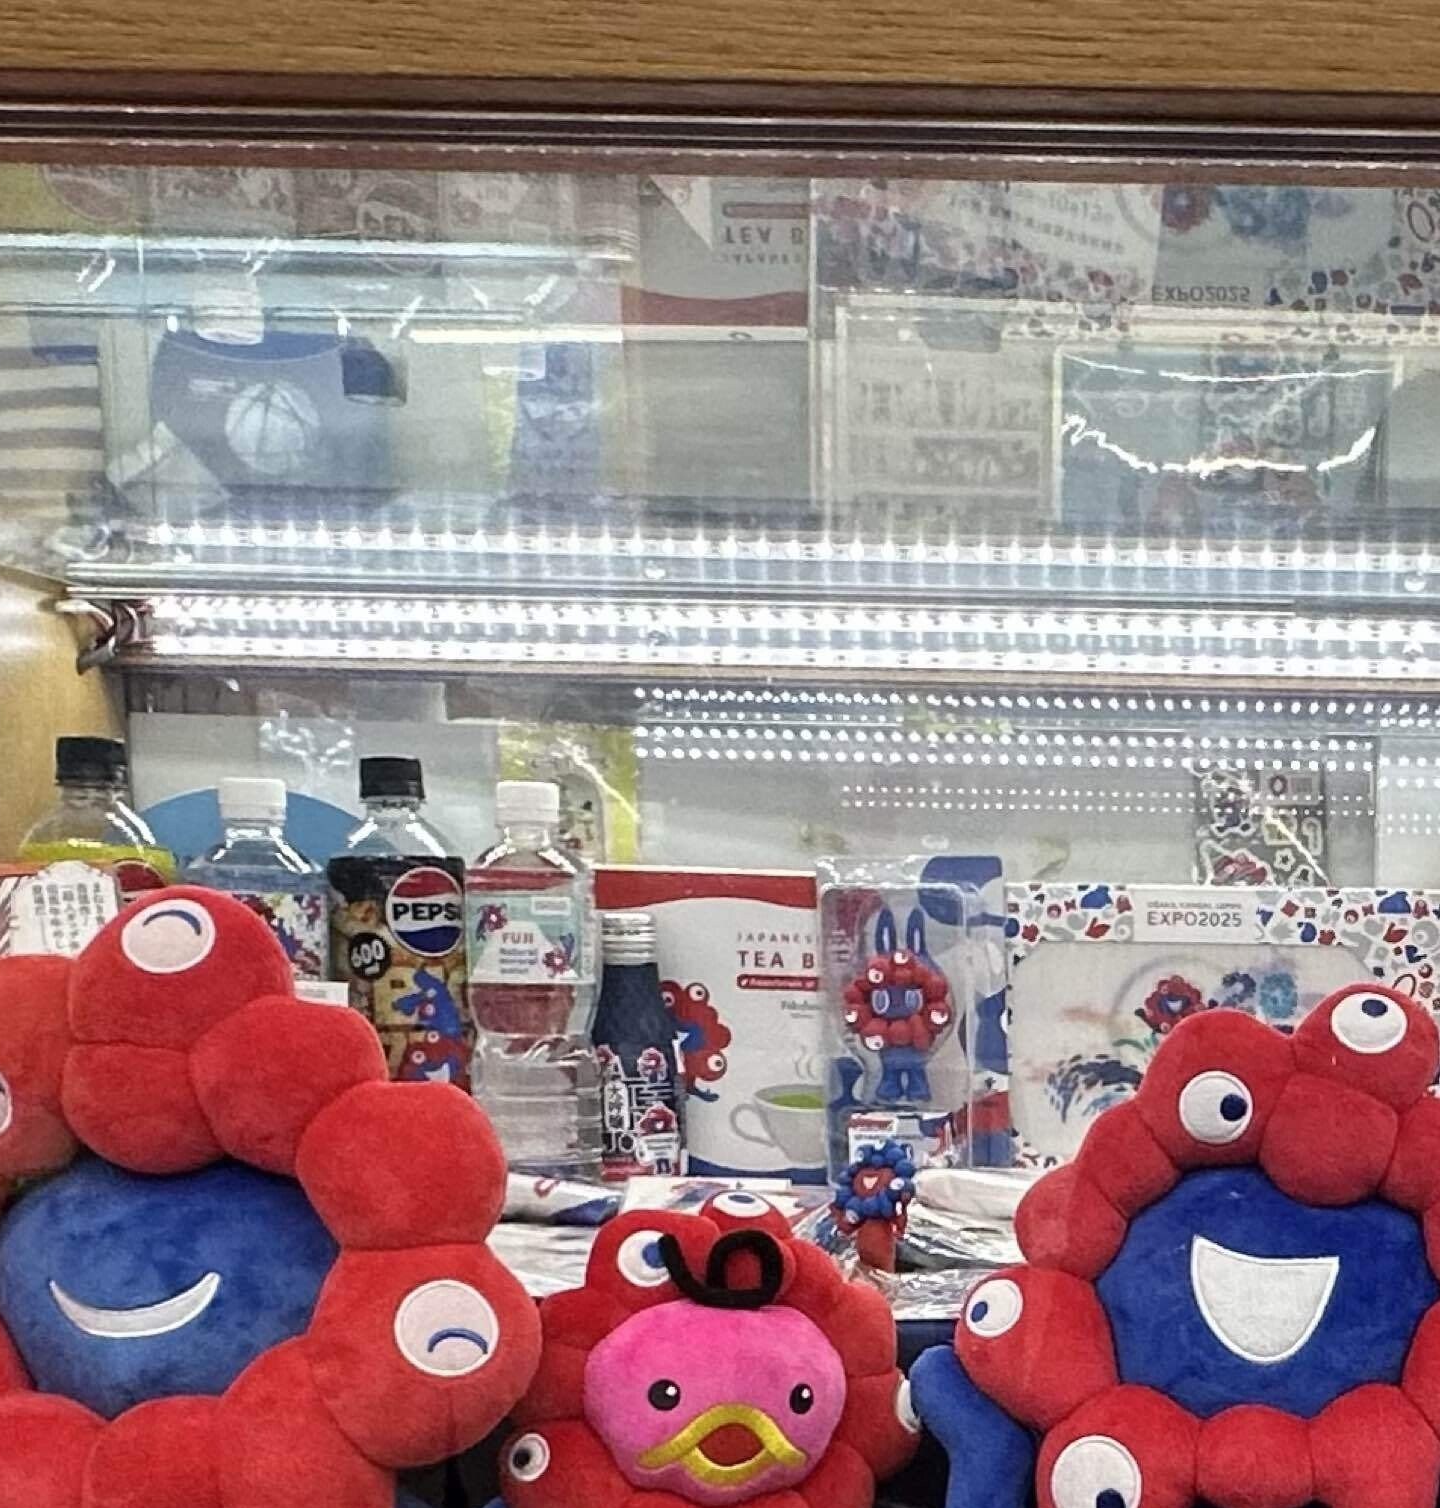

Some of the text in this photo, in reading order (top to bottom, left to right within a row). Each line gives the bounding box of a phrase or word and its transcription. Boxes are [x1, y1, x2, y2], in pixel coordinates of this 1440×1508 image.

[1146, 910, 1242, 928] EXPO2025
[502, 931, 535, 945] FUJI
[737, 950, 785, 969] TEA
